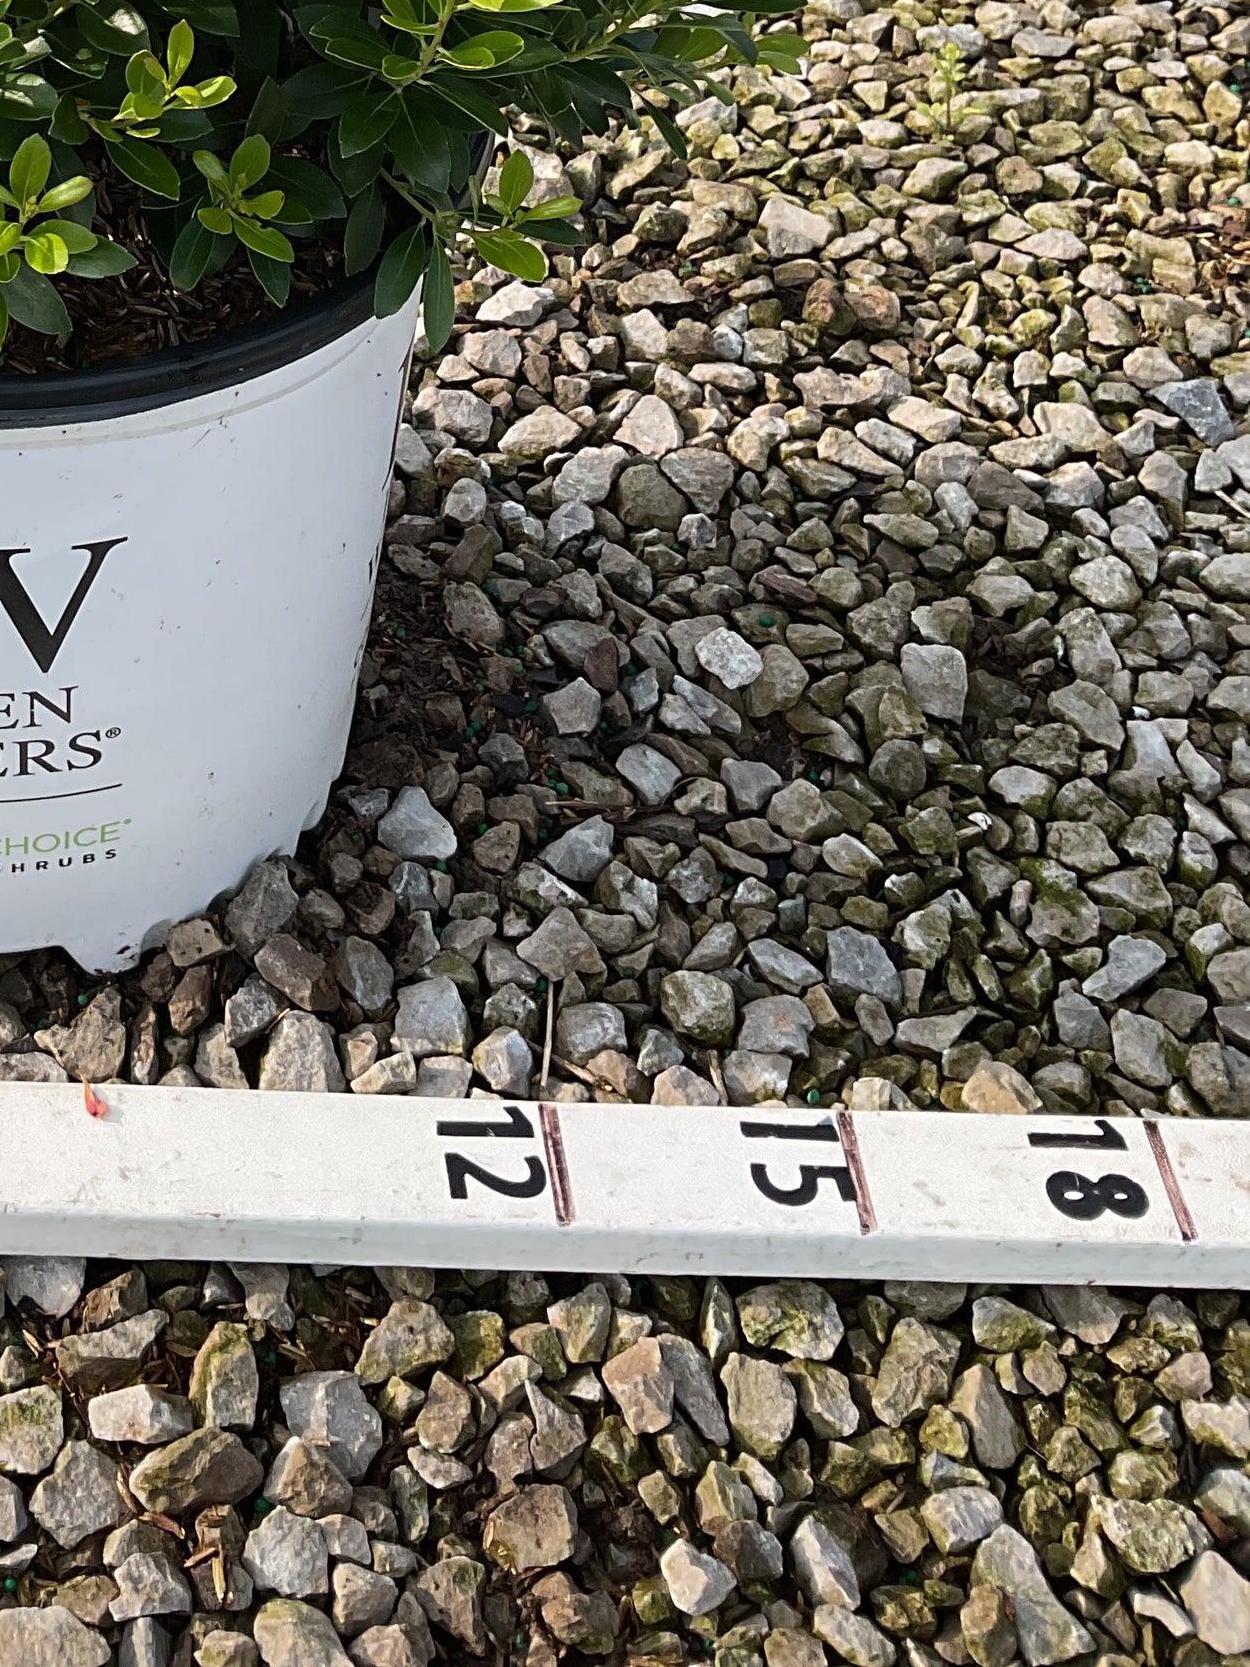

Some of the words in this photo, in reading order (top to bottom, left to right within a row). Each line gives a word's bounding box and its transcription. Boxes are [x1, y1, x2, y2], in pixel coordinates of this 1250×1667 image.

[436, 1106, 547, 1200] 12
[740, 1119, 857, 1207] 15
[1027, 1119, 1150, 1222] 18
